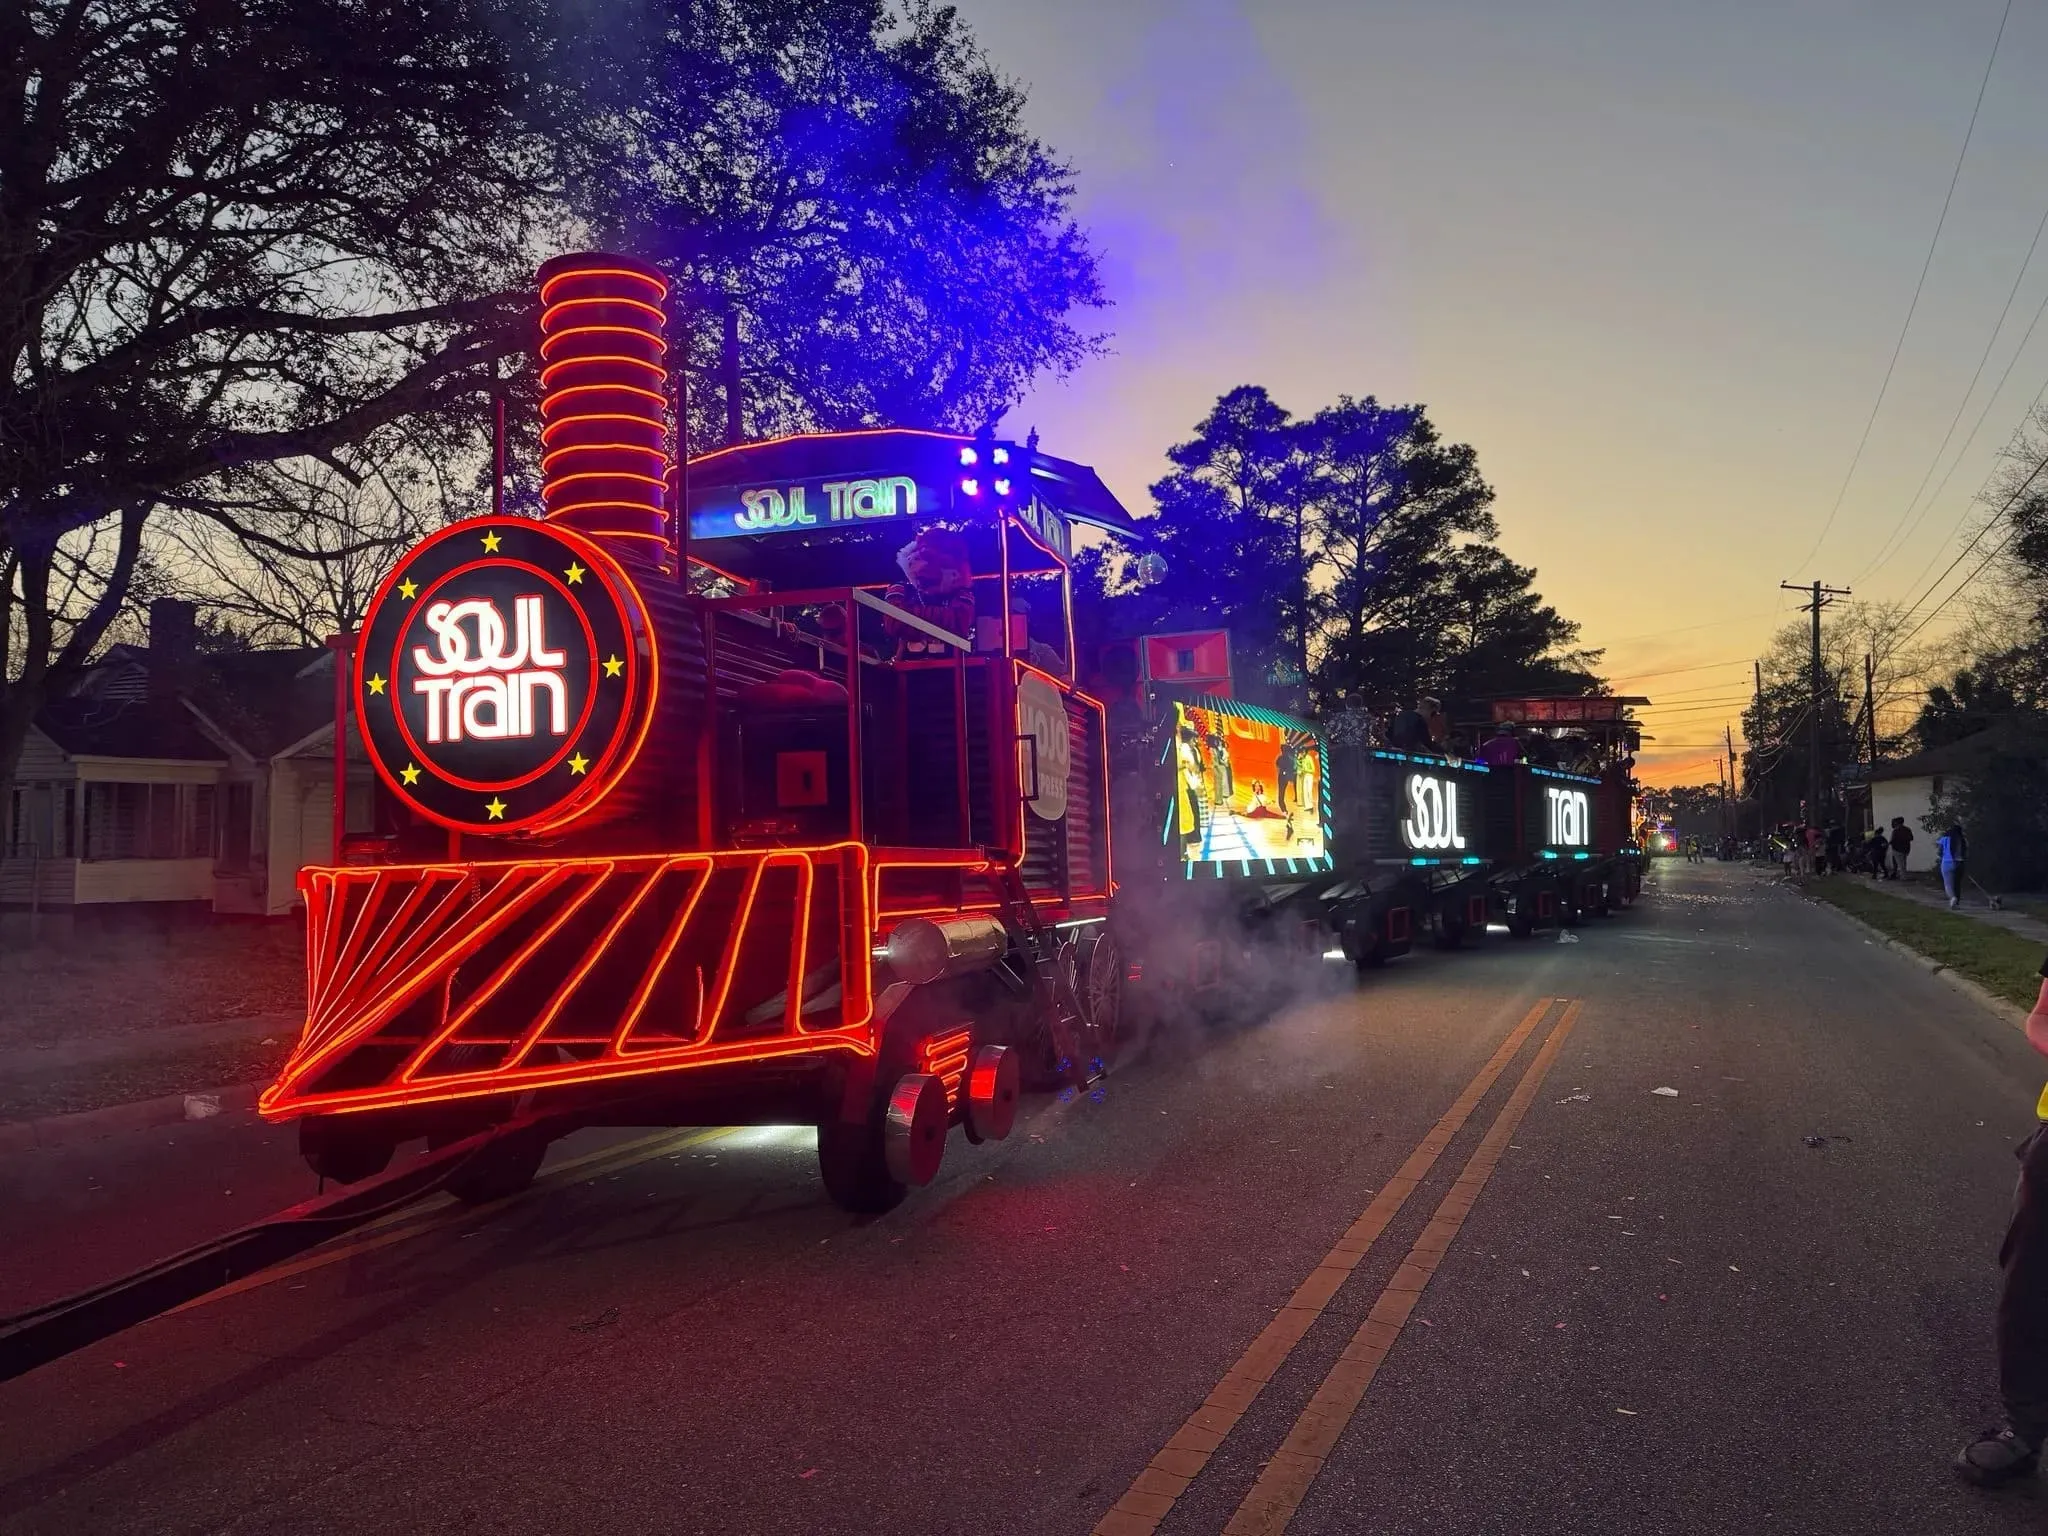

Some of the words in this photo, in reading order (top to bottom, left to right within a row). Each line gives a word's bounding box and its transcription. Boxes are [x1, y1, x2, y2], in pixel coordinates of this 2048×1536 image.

[734, 486, 817, 530] SOUL
[412, 594, 567, 676] SOUL
[1404, 773, 1466, 849] SOUL
